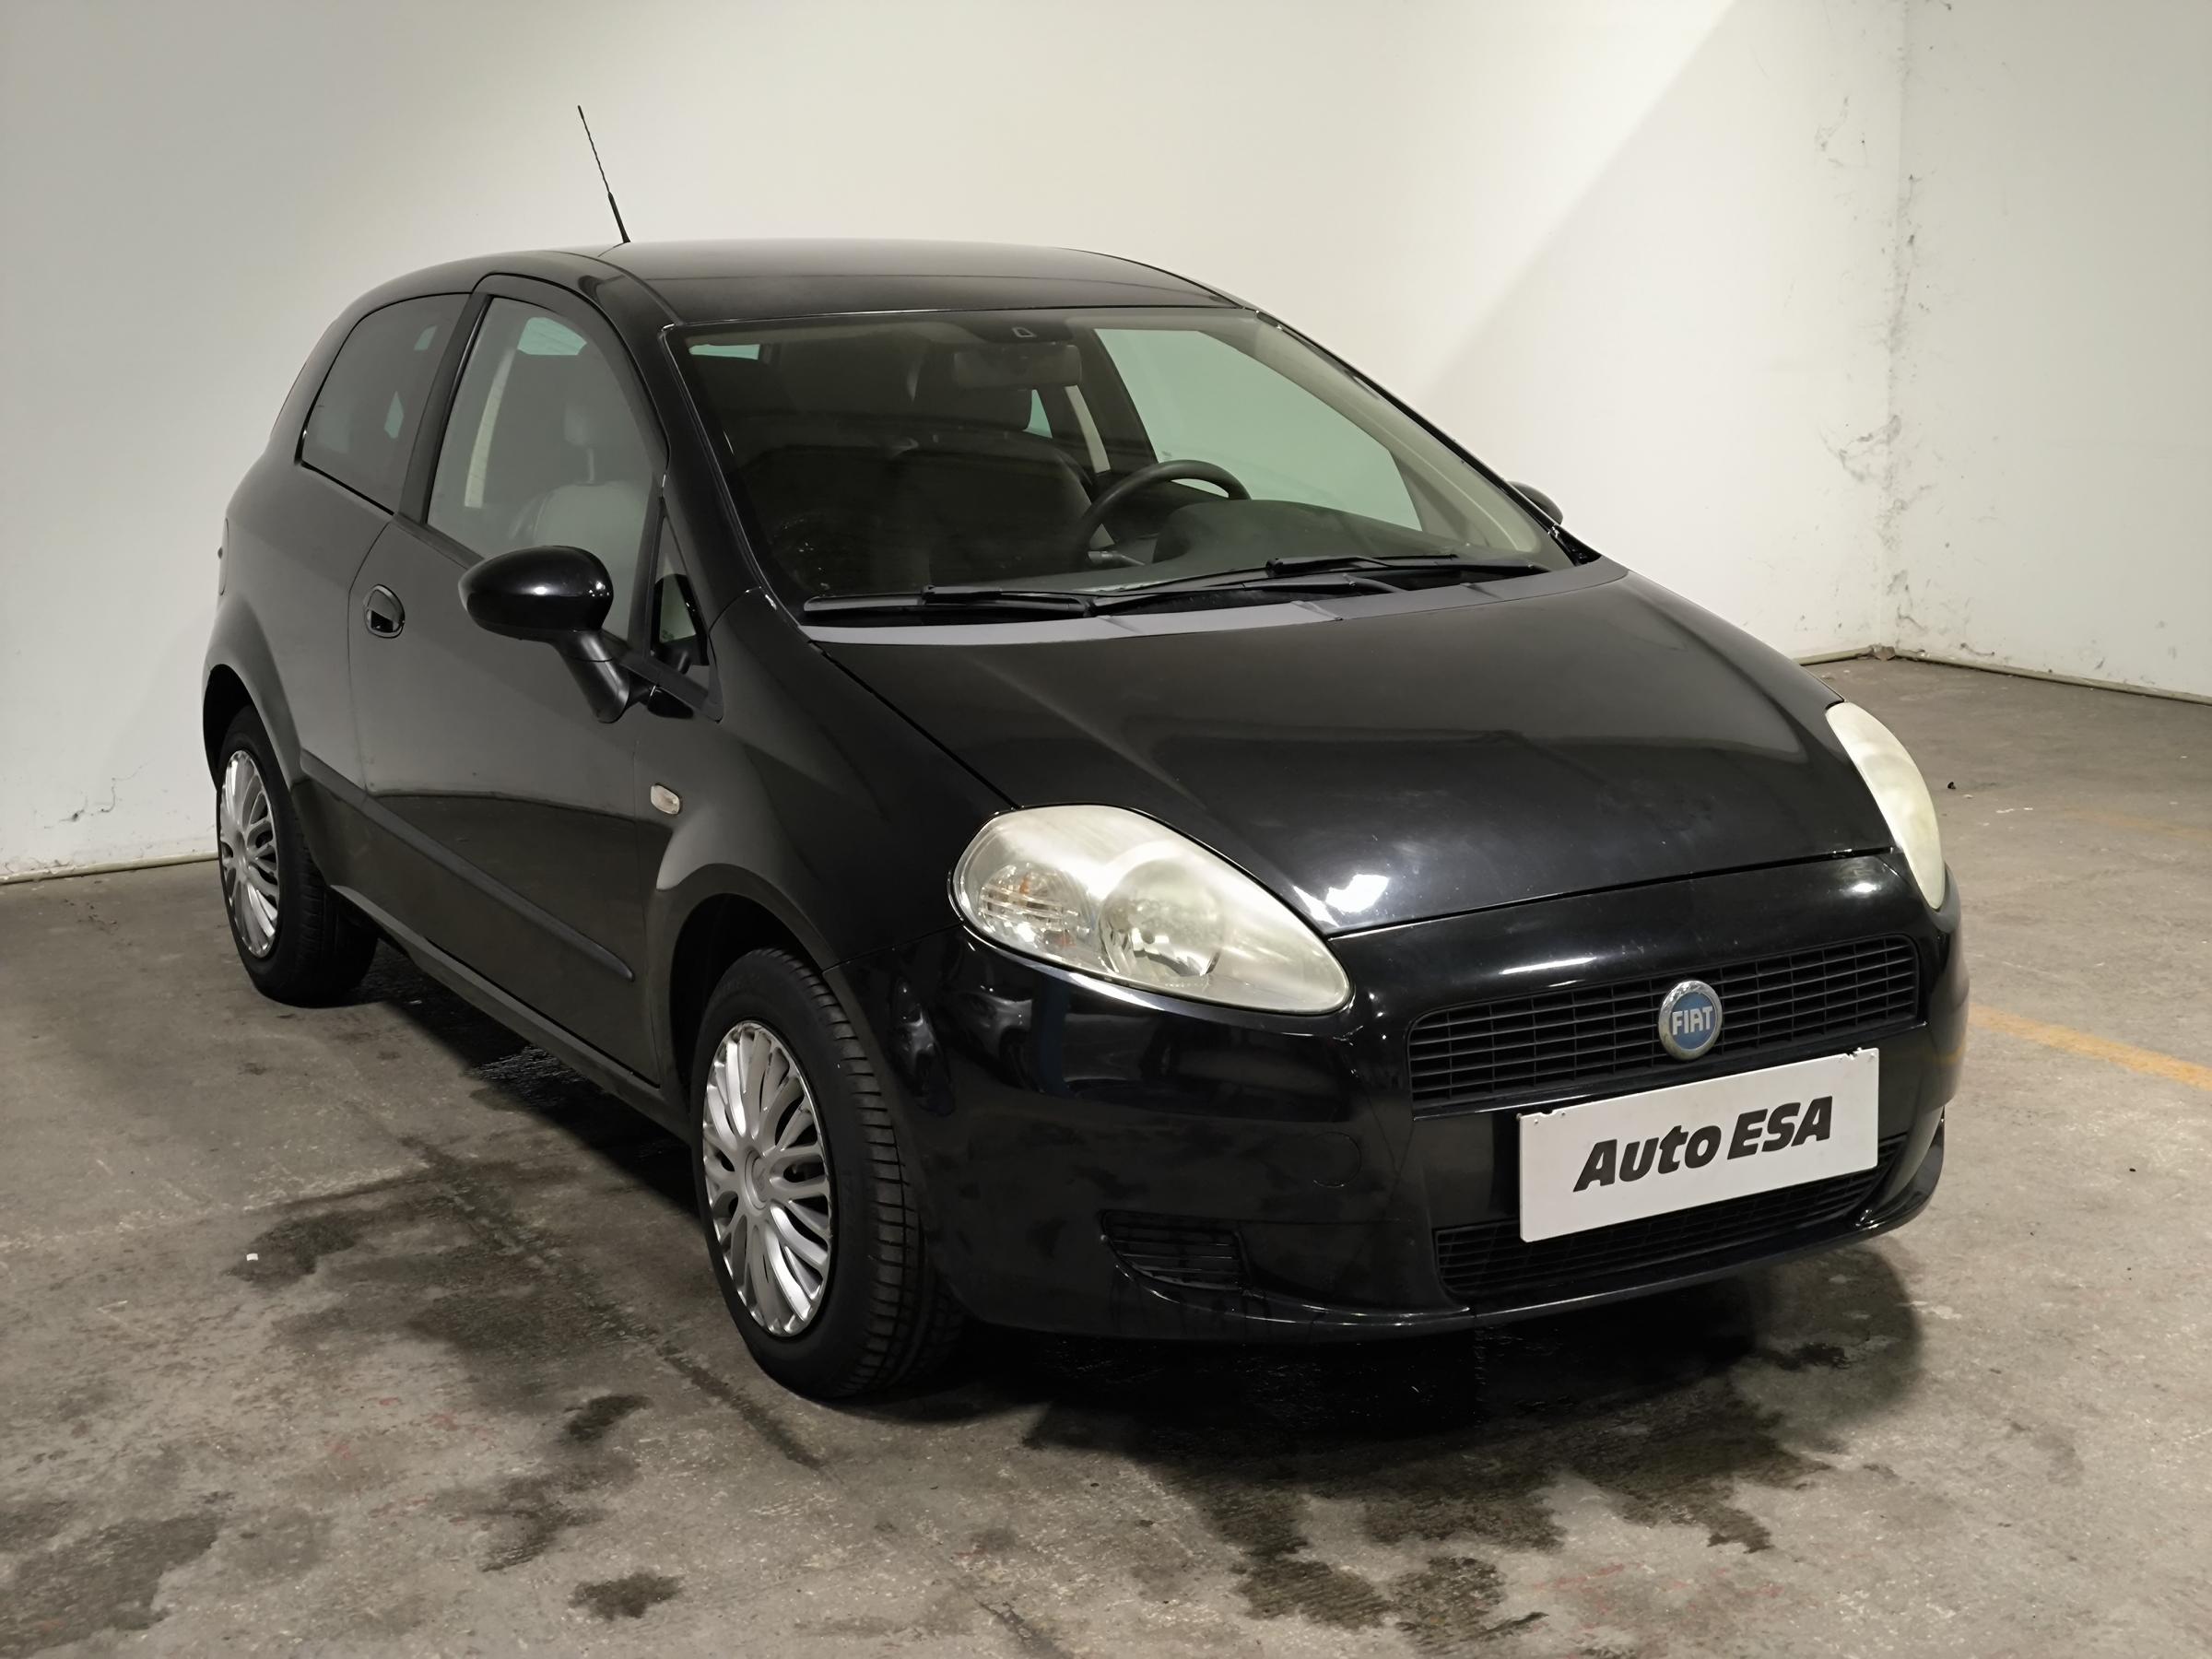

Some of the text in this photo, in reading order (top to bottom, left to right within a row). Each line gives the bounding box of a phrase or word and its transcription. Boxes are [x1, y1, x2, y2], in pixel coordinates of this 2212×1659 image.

[1672, 1006, 1712, 1036] FIAT
[1573, 1096, 1832, 1192] Auto ESA
